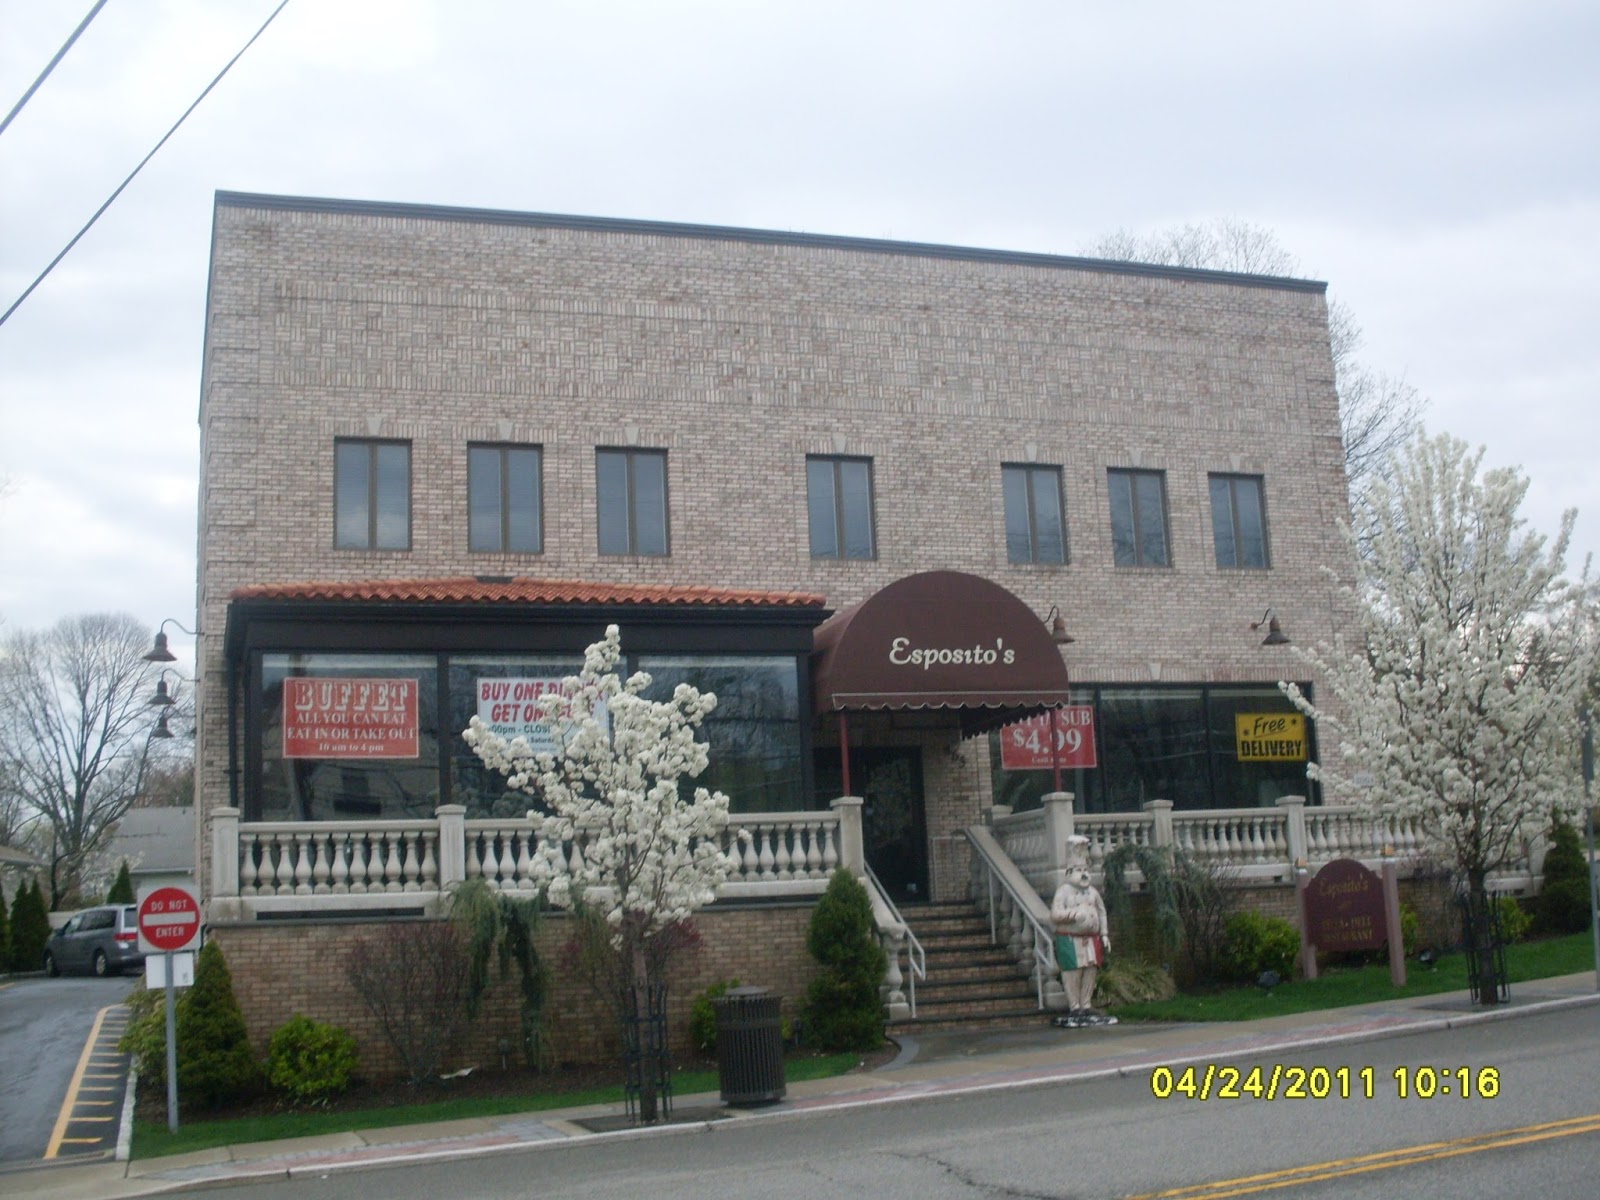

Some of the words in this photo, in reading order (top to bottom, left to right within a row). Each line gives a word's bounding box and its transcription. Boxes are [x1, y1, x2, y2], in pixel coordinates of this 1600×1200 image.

[889, 637, 1015, 670] Esposito's
[295, 681, 408, 711] BUFFET
[481, 682, 510, 701] BUY
[514, 682, 544, 701] ONE
[296, 712, 321, 724] ALL
[323, 712, 350, 724] YOU
[353, 712, 379, 724] CAN
[382, 712, 406, 724] EAT
[491, 703, 521, 723] GET
[523, 704, 550, 723] ON
[1061, 710, 1091, 726] SUB
[287, 727, 312, 739] EAT
[314, 727, 328, 739] IN
[331, 727, 350, 739] OR
[354, 727, 386, 739] TAKE
[388, 727, 417, 739] OUT
[1253, 716, 1287, 736] Free
[368, 745, 384, 753] pm
[1241, 740, 1302, 756] DELIVERY
[151, 901, 164, 912] DO
[169, 899, 187, 911] NOT
[156, 926, 185, 938] ENTER
